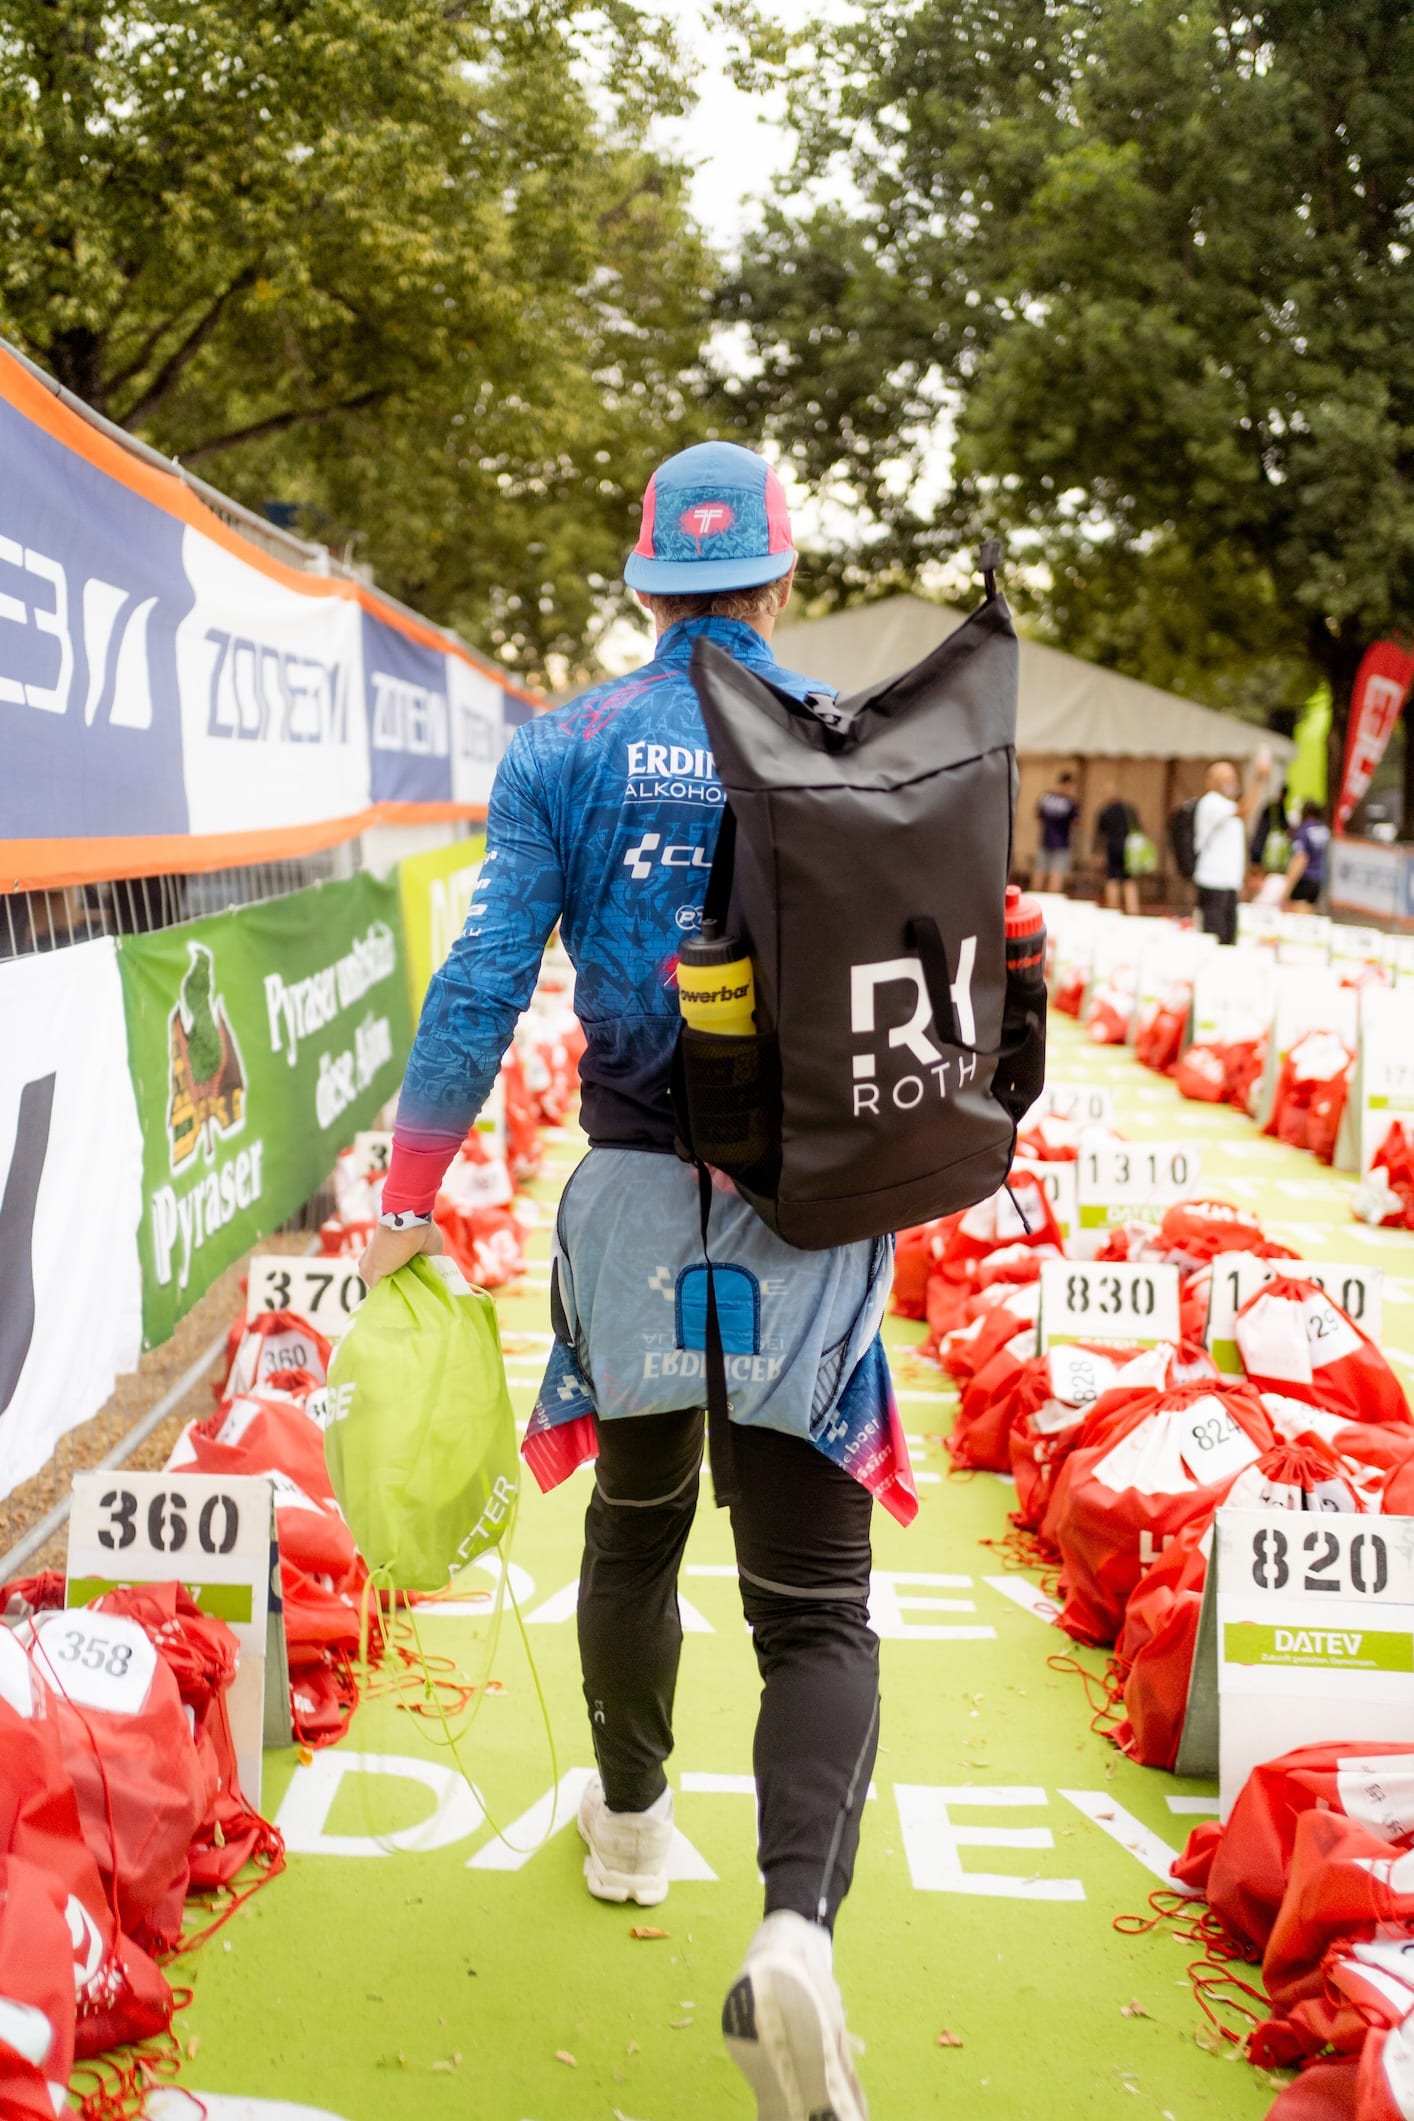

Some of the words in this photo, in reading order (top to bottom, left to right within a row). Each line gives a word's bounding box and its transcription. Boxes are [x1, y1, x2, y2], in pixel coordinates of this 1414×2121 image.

[680, 983, 750, 1004] owerbar
[853, 1052, 977, 1117] ROTH
[1089, 1153, 1188, 1185] 1310
[151, 1139, 264, 1288] Pyraser
[264, 1271, 367, 1313] 370
[1067, 1275, 1155, 1315] 830
[1192, 1412, 1241, 1451] 824
[98, 1490, 240, 1555] 360
[1252, 1528, 1388, 1594] 820
[58, 1630, 133, 1677] 358
[1274, 1629, 1363, 1656] DATEV
